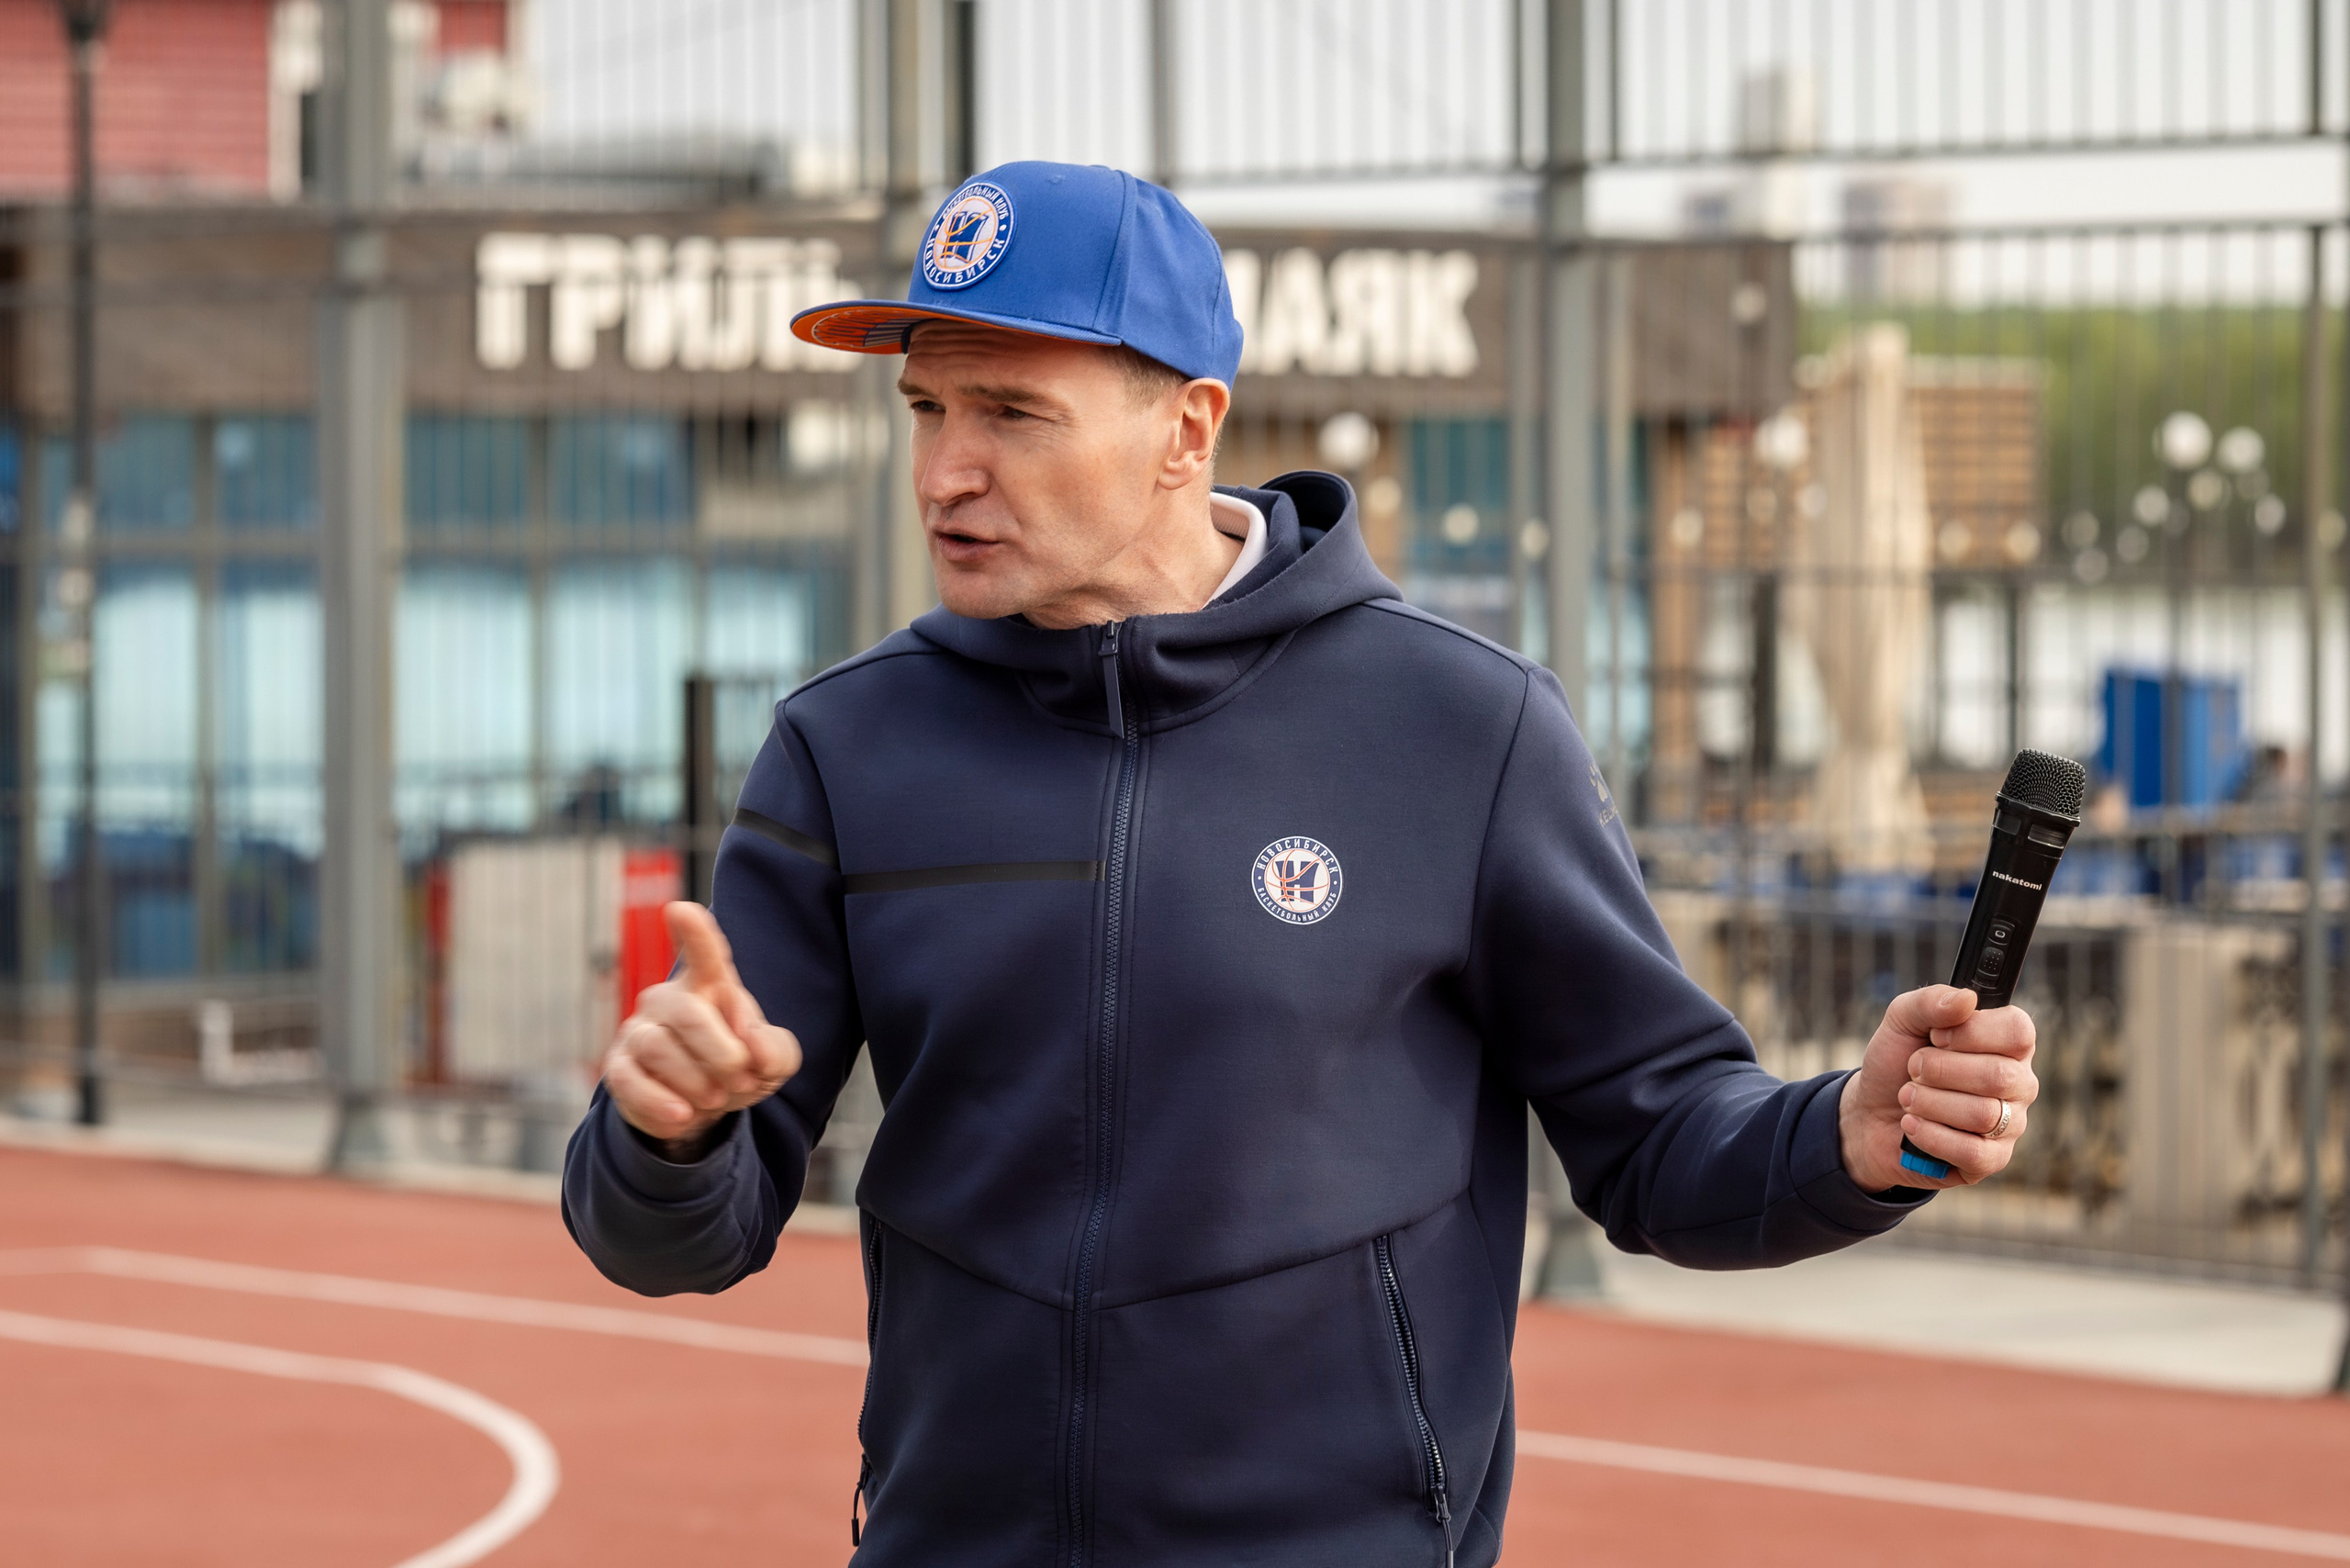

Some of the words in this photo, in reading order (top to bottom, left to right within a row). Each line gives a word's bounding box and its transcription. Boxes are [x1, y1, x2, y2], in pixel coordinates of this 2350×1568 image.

[994, 196, 1009, 220] КЛУБ
[925, 238, 1005, 284] НОВОСИБИРСК
[476, 232, 865, 373] ГРИЛЬ
[1257, 838, 1338, 874] НОВОСИБИРСК
[1992, 870, 2042, 890] nakatomi
[1258, 887, 1320, 922] БАСКЕТБОЛЬНЫЙ
[1322, 891, 1337, 913] КЛУБ
